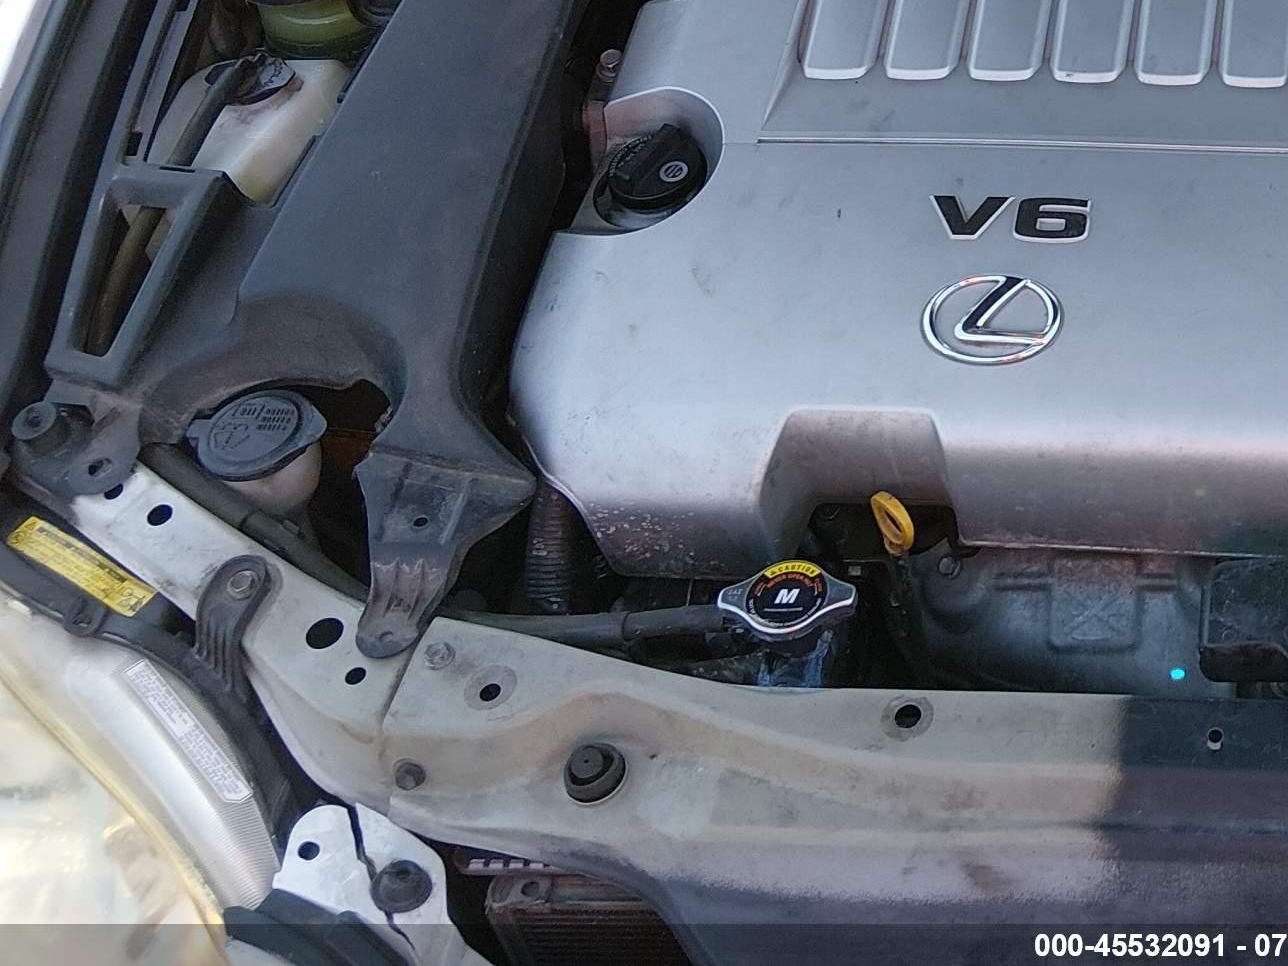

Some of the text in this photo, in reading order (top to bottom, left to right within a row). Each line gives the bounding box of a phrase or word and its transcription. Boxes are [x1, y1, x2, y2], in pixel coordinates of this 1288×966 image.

[928, 194, 1093, 244] V6
[777, 563, 817, 575] CAUTION
[773, 588, 800, 604] M
